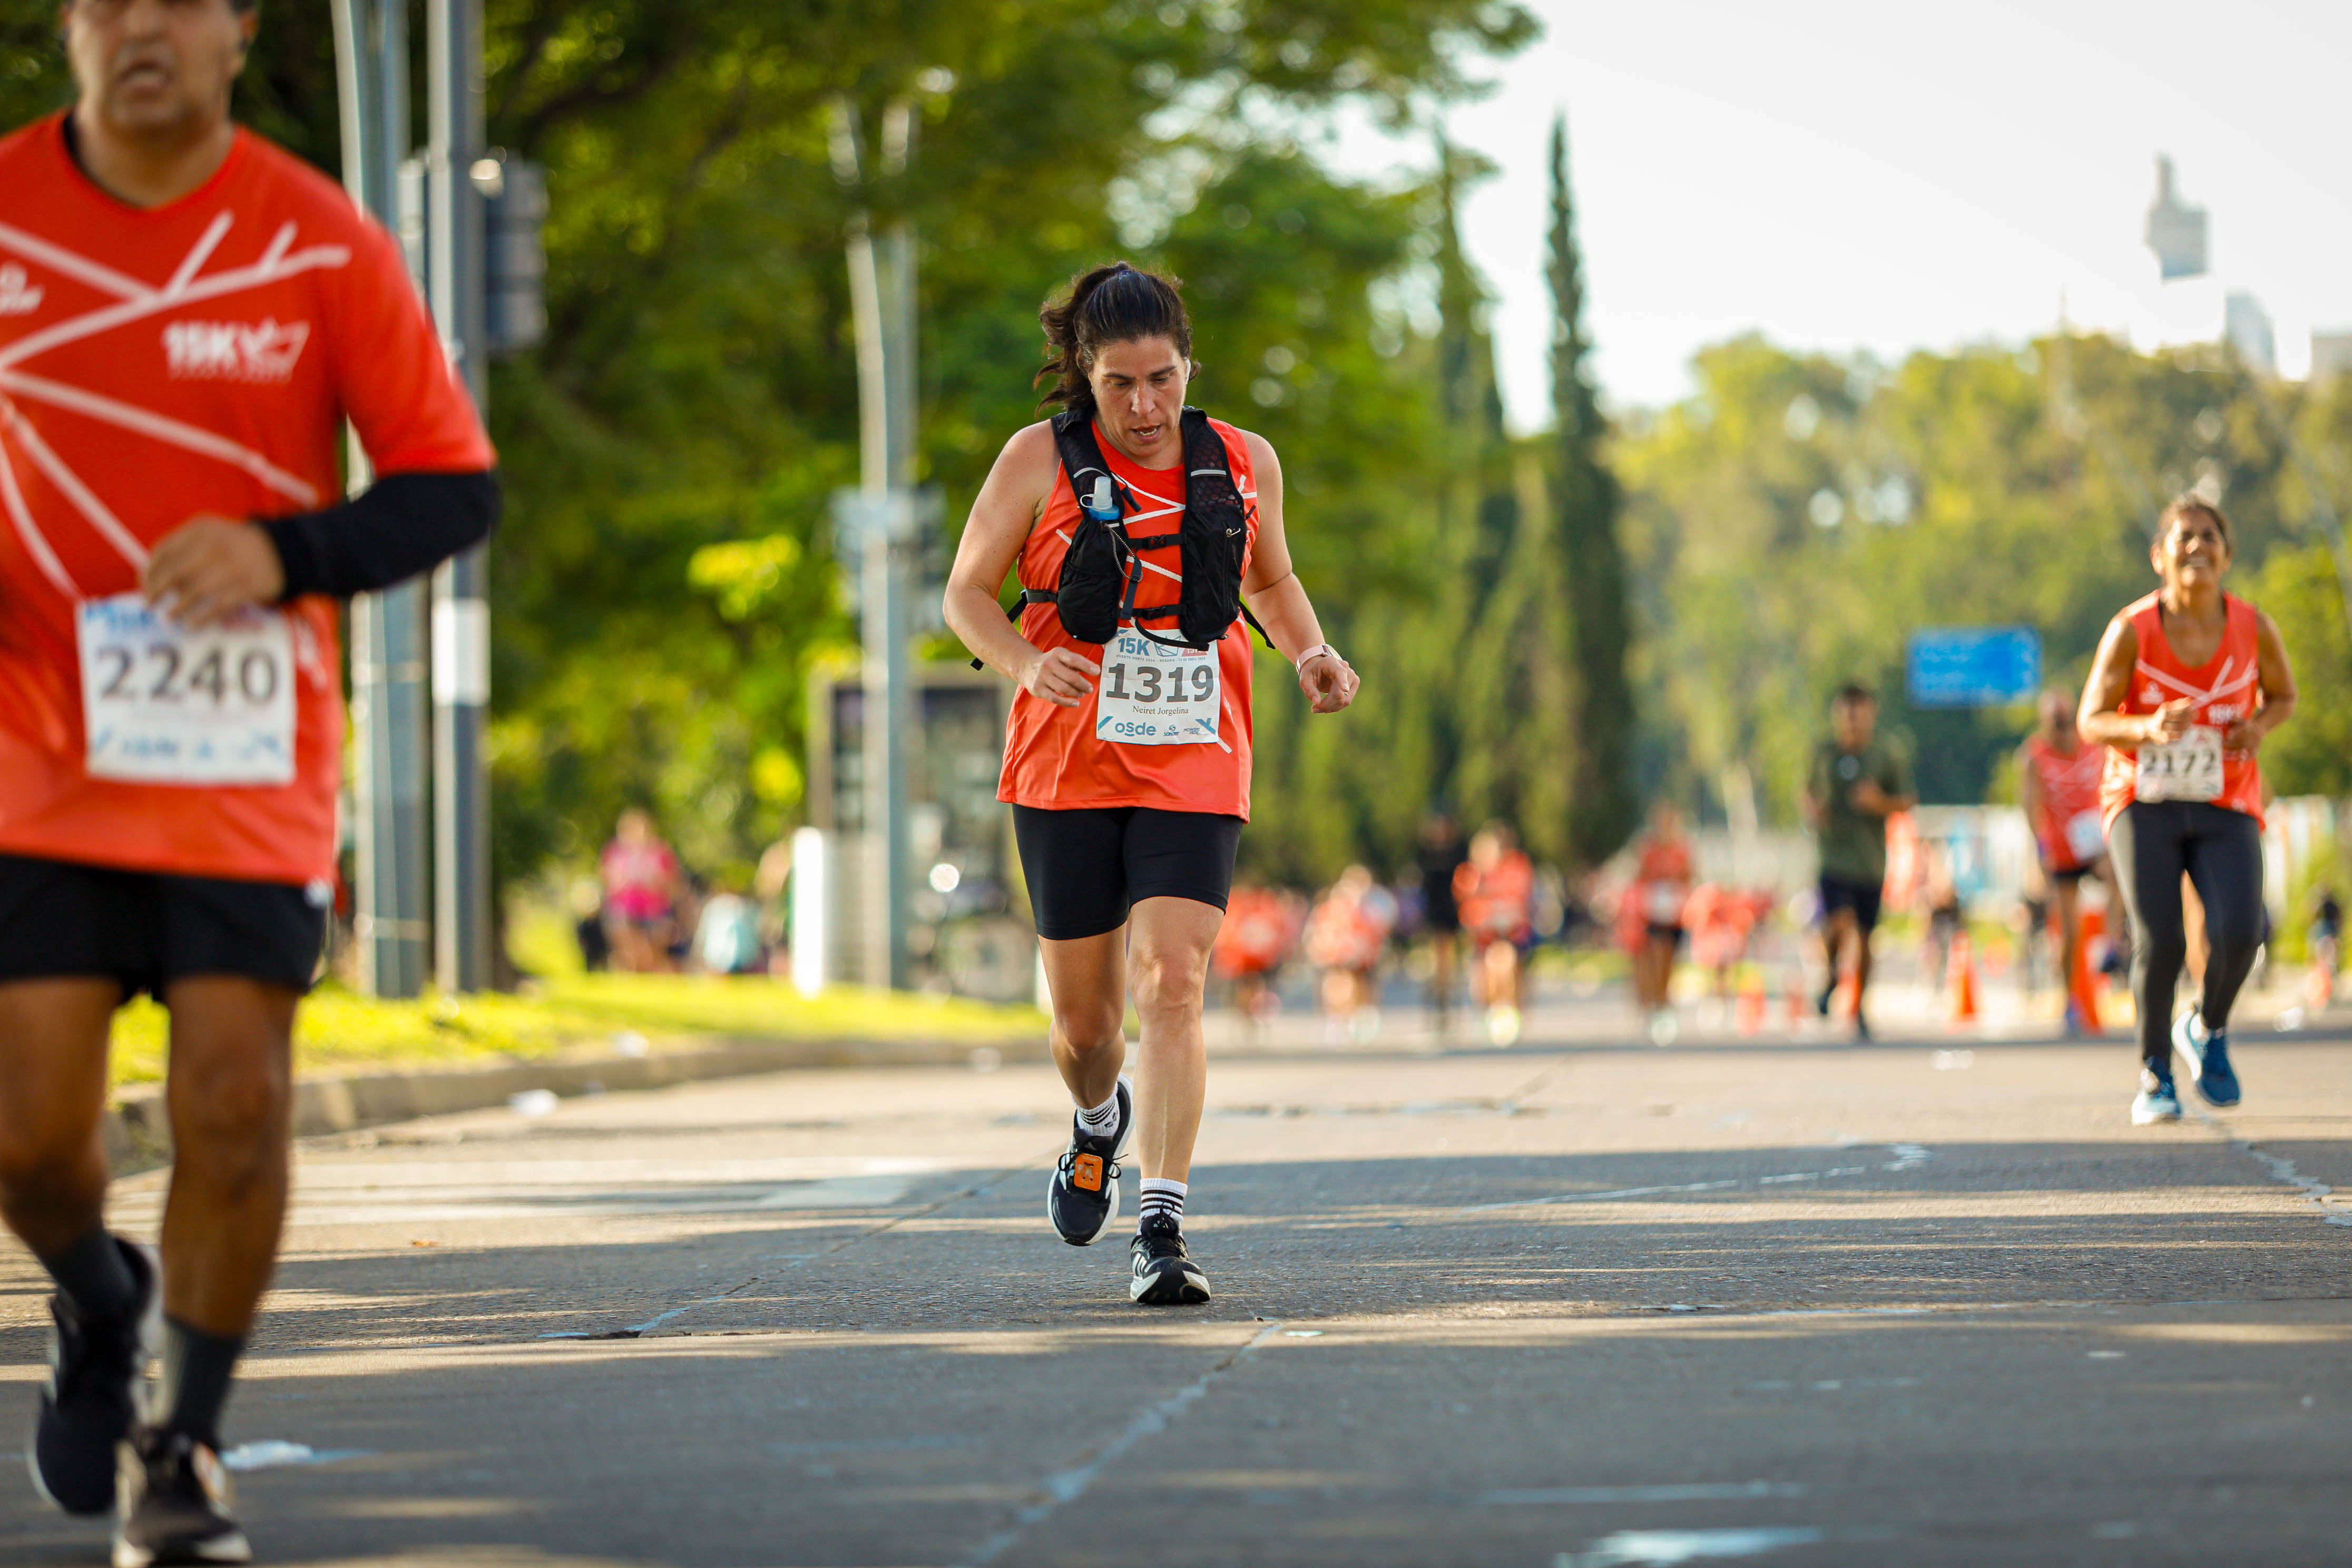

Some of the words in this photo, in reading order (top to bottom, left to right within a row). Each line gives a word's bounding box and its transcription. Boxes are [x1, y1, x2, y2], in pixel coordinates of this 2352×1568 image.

[1118, 638, 1151, 656] 15K
[96, 644, 278, 707] 2240
[1106, 663, 1214, 703] 1319
[1133, 705, 1155, 714] Neiret
[1157, 707, 1189, 716] Jorgelina
[2143, 749, 2216, 773] 2172
